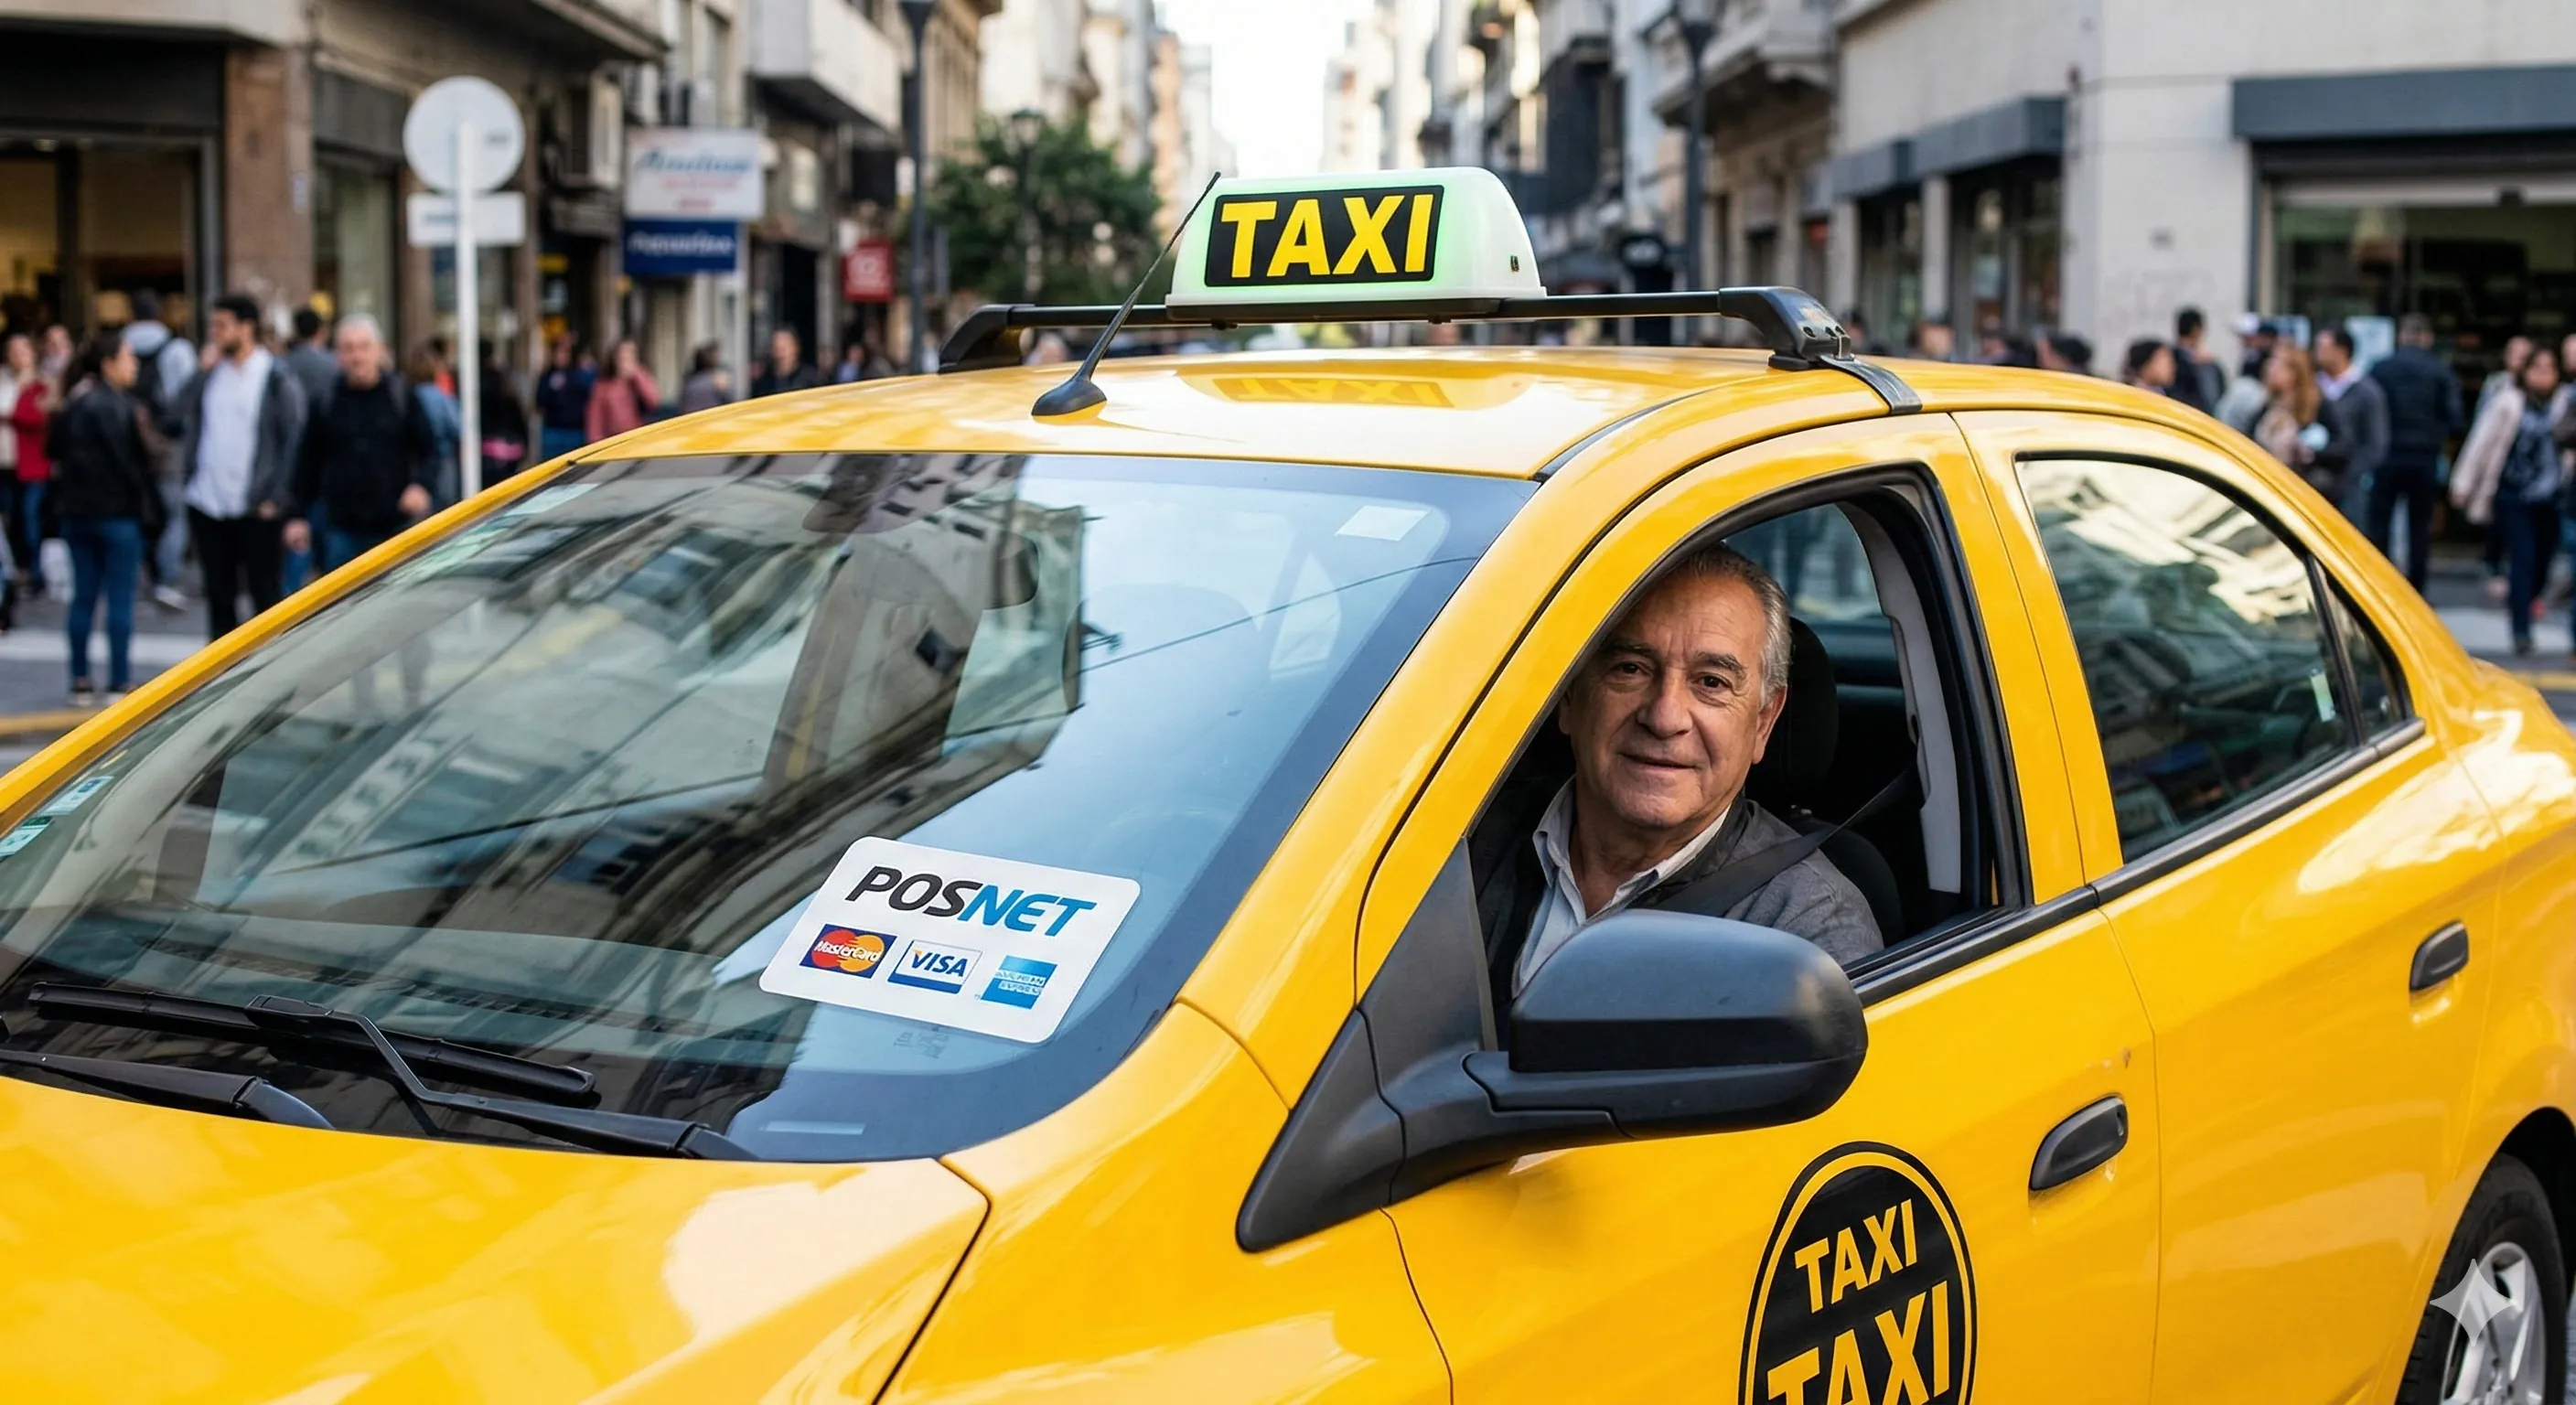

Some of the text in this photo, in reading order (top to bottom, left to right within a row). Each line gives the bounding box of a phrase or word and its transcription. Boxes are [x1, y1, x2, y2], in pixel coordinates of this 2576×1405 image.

[1221, 194, 1433, 278] TAXI
[844, 865, 1098, 937] POSNET
[911, 948, 968, 978] VISA
[1794, 1198, 1917, 1314] TAXI
[1767, 1280, 1949, 1405] TAXI
